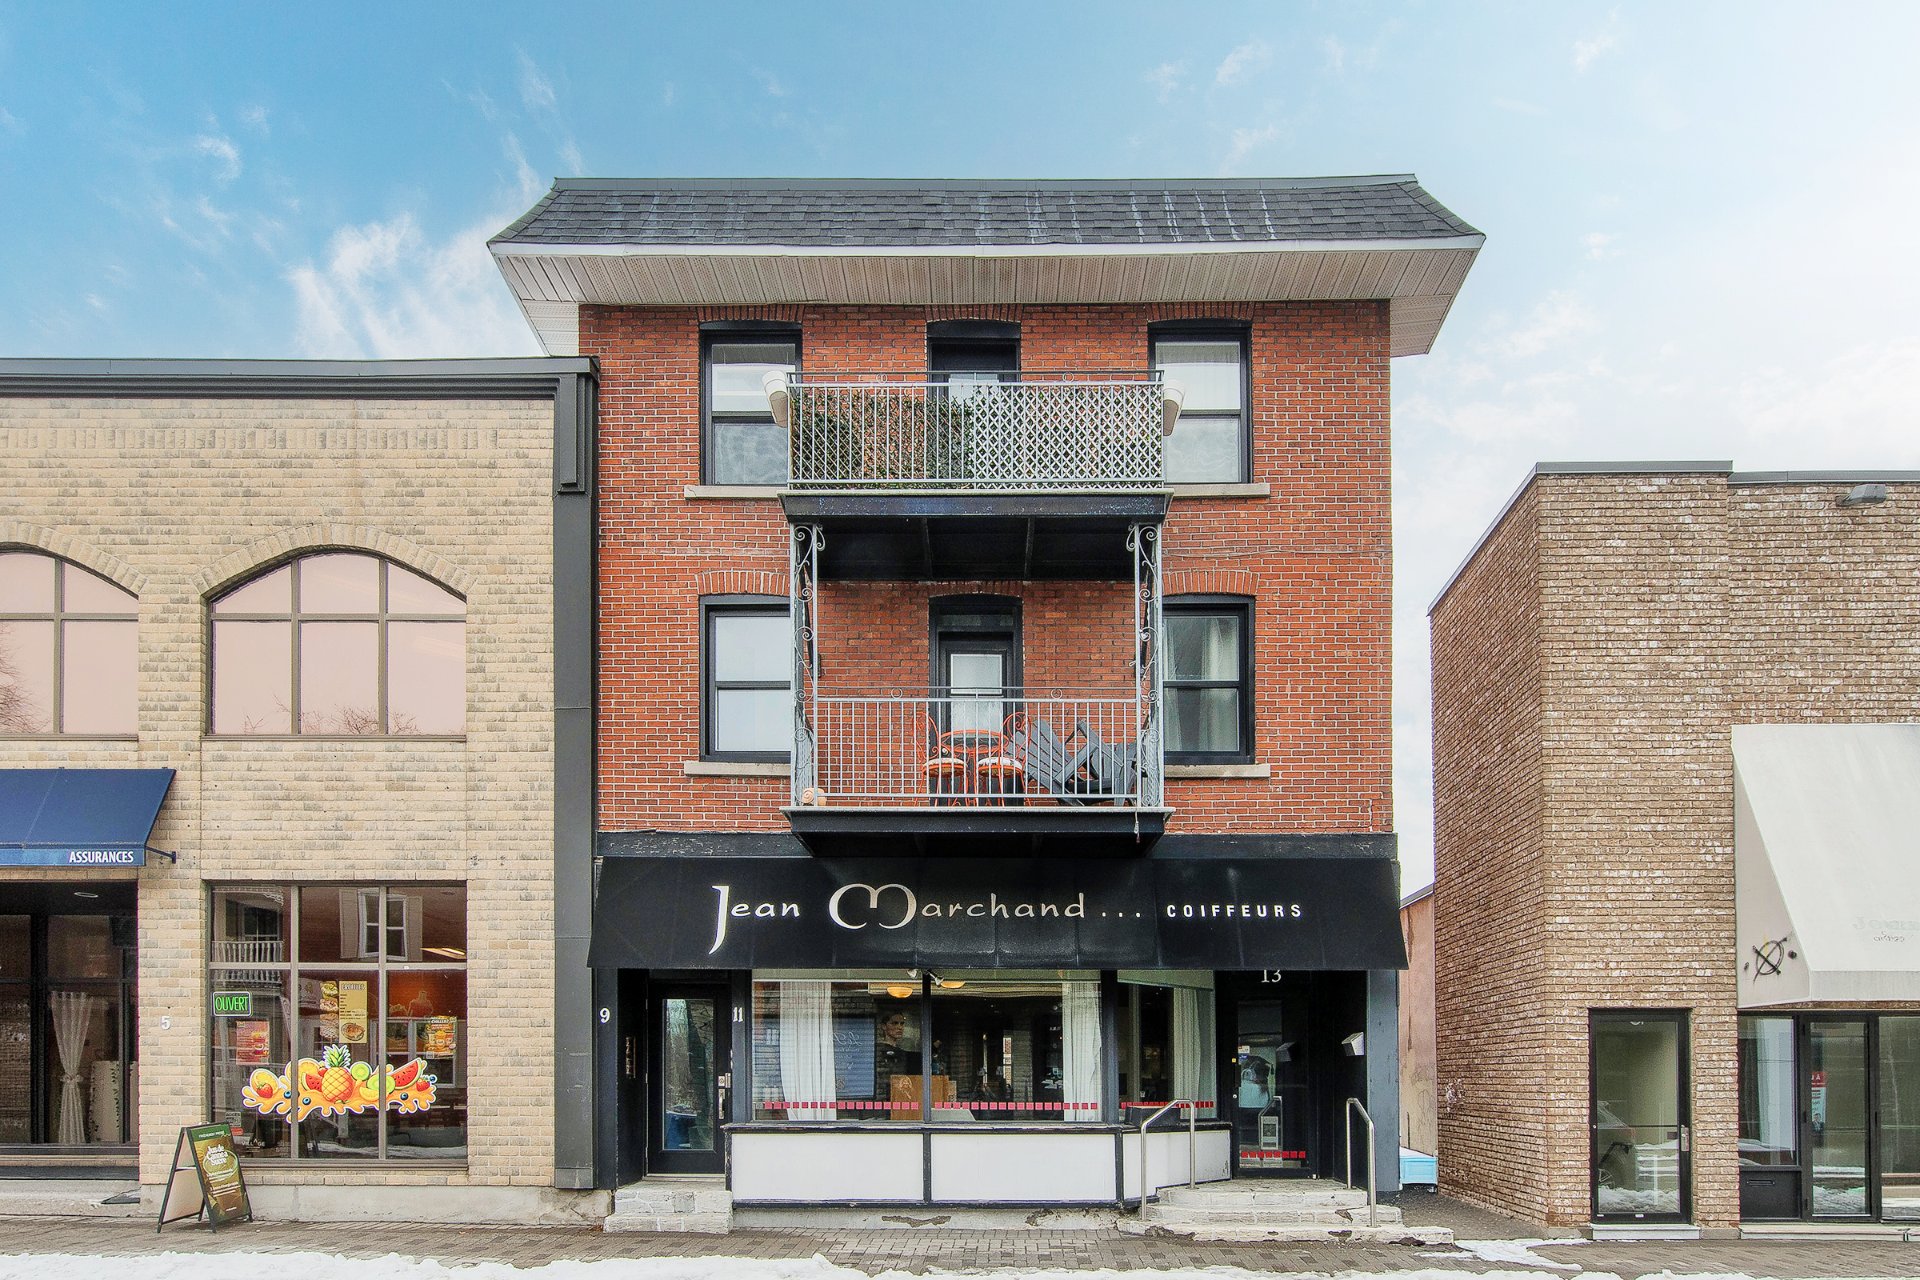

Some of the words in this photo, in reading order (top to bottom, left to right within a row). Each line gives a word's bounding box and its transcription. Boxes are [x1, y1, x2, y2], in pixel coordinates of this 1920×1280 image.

[69, 851, 134, 863] ASSURANCES
[708, 885, 801, 955] Jean
[828, 883, 1086, 930] Marchand
[1166, 904, 1302, 918] COIFFEURS
[215, 996, 248, 1011] OUVERT
[599, 1007, 611, 1024] 9
[731, 1006, 745, 1023] 11
[161, 1016, 171, 1030] 5
